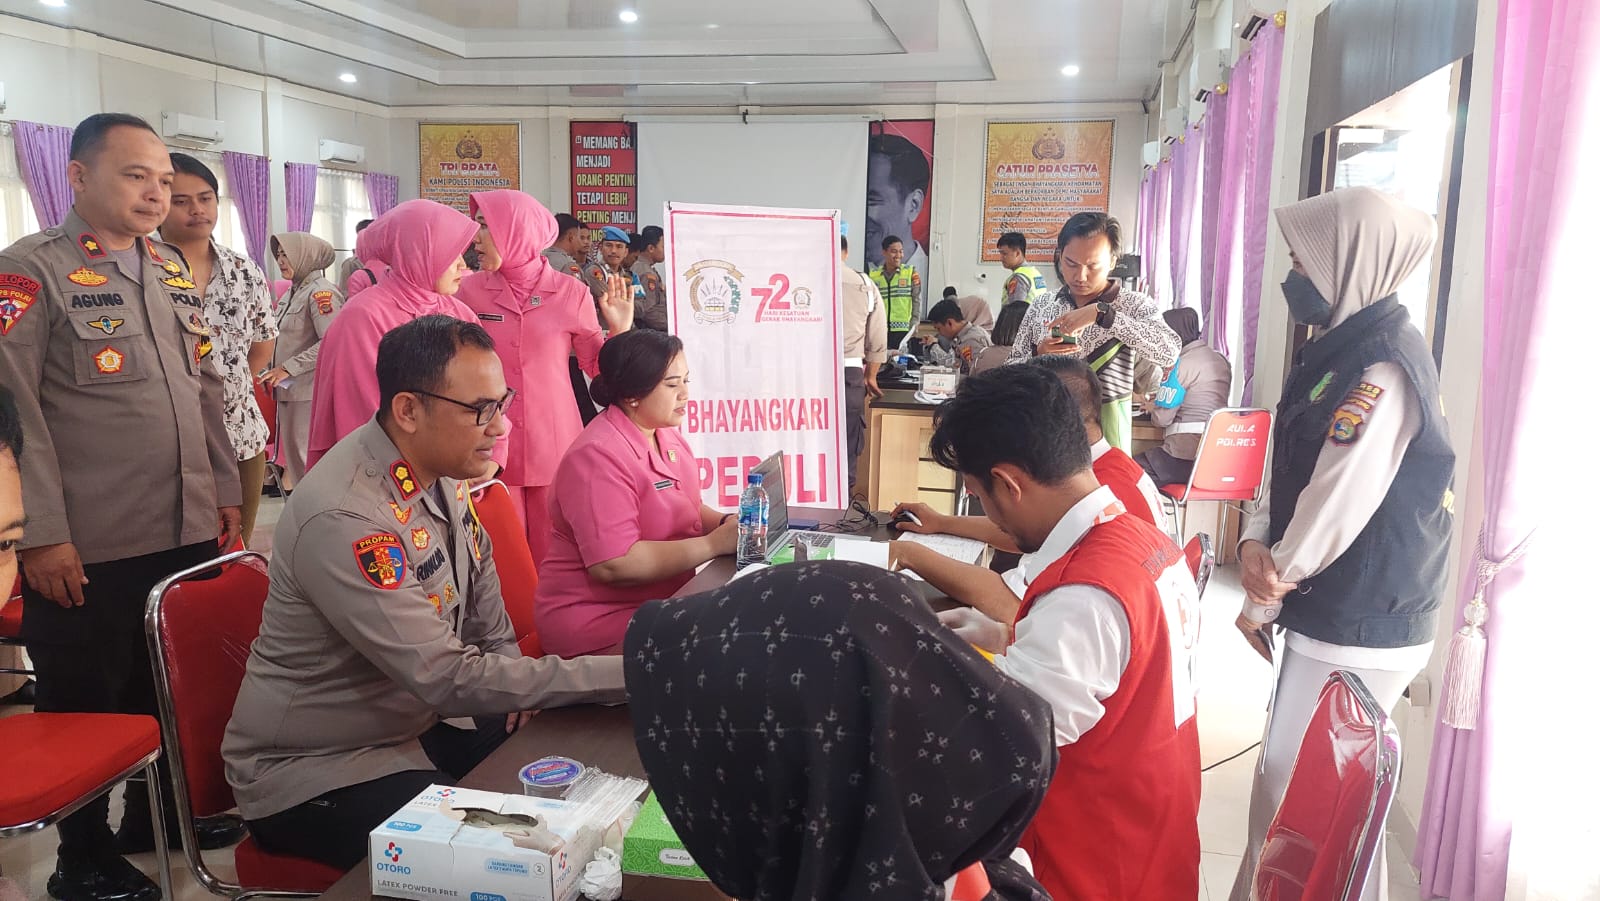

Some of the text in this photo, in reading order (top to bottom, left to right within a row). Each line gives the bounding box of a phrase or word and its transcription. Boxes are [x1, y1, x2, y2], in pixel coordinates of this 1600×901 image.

[576, 155, 611, 168] MENJADI
[429, 178, 446, 186] KAMI
[448, 178, 471, 186] POLISI
[576, 174, 603, 186] ORANG
[576, 192, 628, 205] TETAPI LEBIH
[576, 211, 610, 223] PENTING
[71, 292, 124, 309] AGUNG
[751, 273, 790, 323] 72
[688, 397, 829, 434] BHAYANGKARI
[1226, 424, 1256, 433] AULA
[1216, 438, 1257, 447] POLRES
[359, 535, 396, 549] PROPAM
[376, 862, 412, 875] OTORO
[377, 879, 402, 889] LATEX
[402, 883, 438, 895] POWDER
[439, 888, 458, 897] FREE
[475, 893, 488, 901] 100
